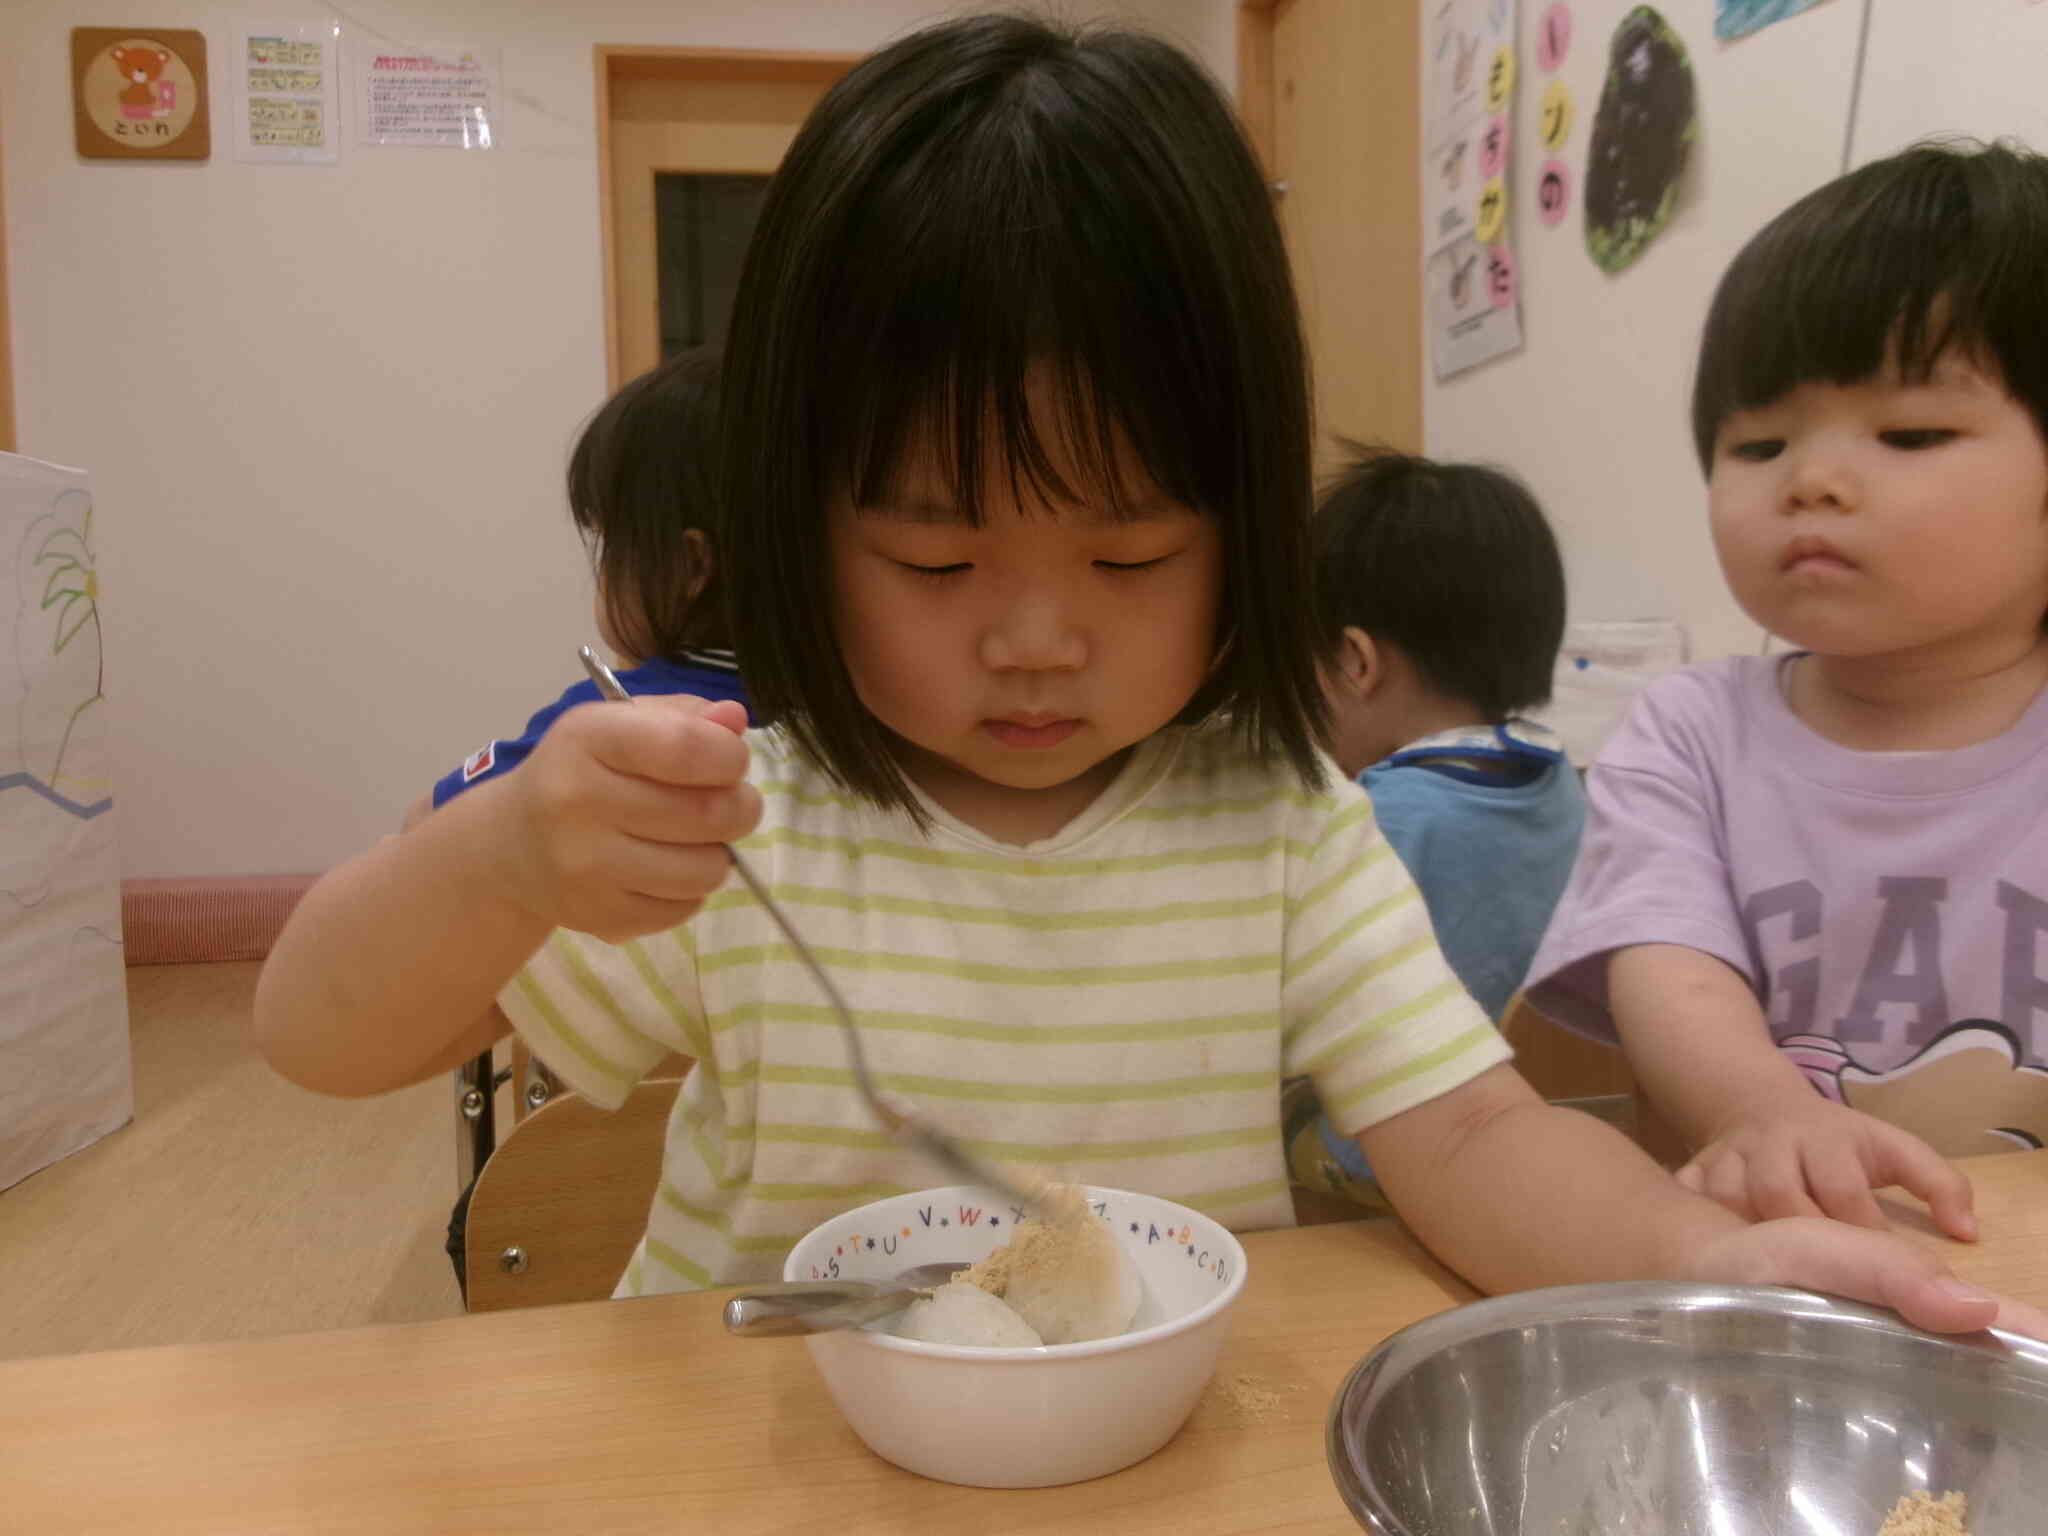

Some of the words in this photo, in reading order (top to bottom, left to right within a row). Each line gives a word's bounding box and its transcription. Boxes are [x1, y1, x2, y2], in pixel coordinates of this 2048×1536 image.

[114, 119, 169, 136] といれ
[919, 1206, 932, 1227] V
[958, 1206, 982, 1227] W
